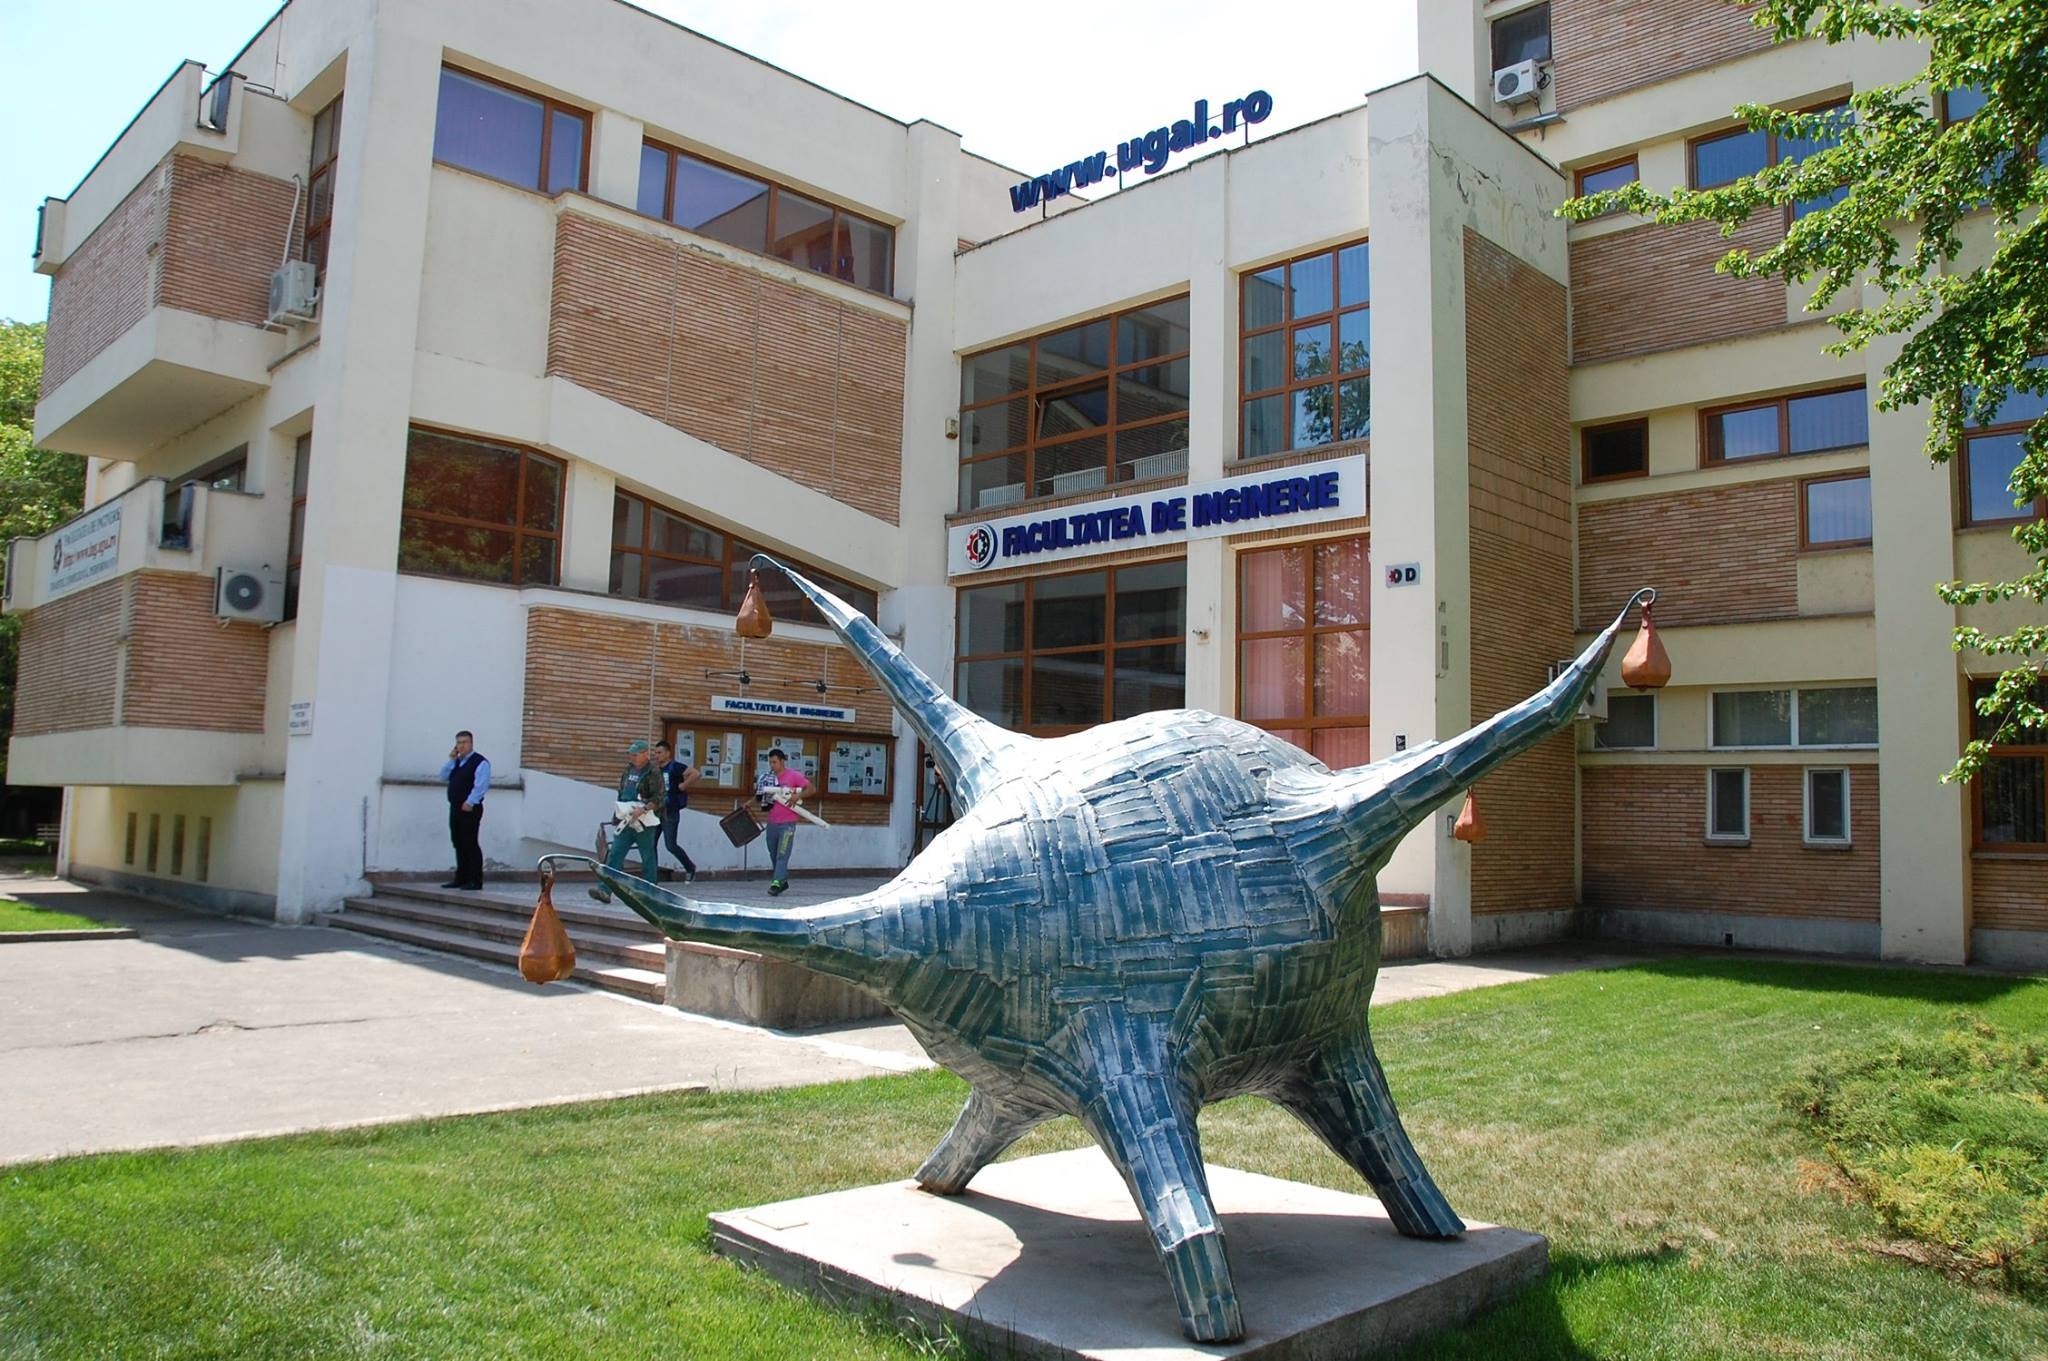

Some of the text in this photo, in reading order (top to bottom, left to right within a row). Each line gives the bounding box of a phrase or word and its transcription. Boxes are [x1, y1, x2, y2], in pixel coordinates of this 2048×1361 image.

[1009, 90, 1273, 213] www.ugal.ro
[1002, 472, 1339, 557] FACULTATEA DE INGINERIE
[725, 700, 845, 719] FACULTATEA DE INGINERIE
